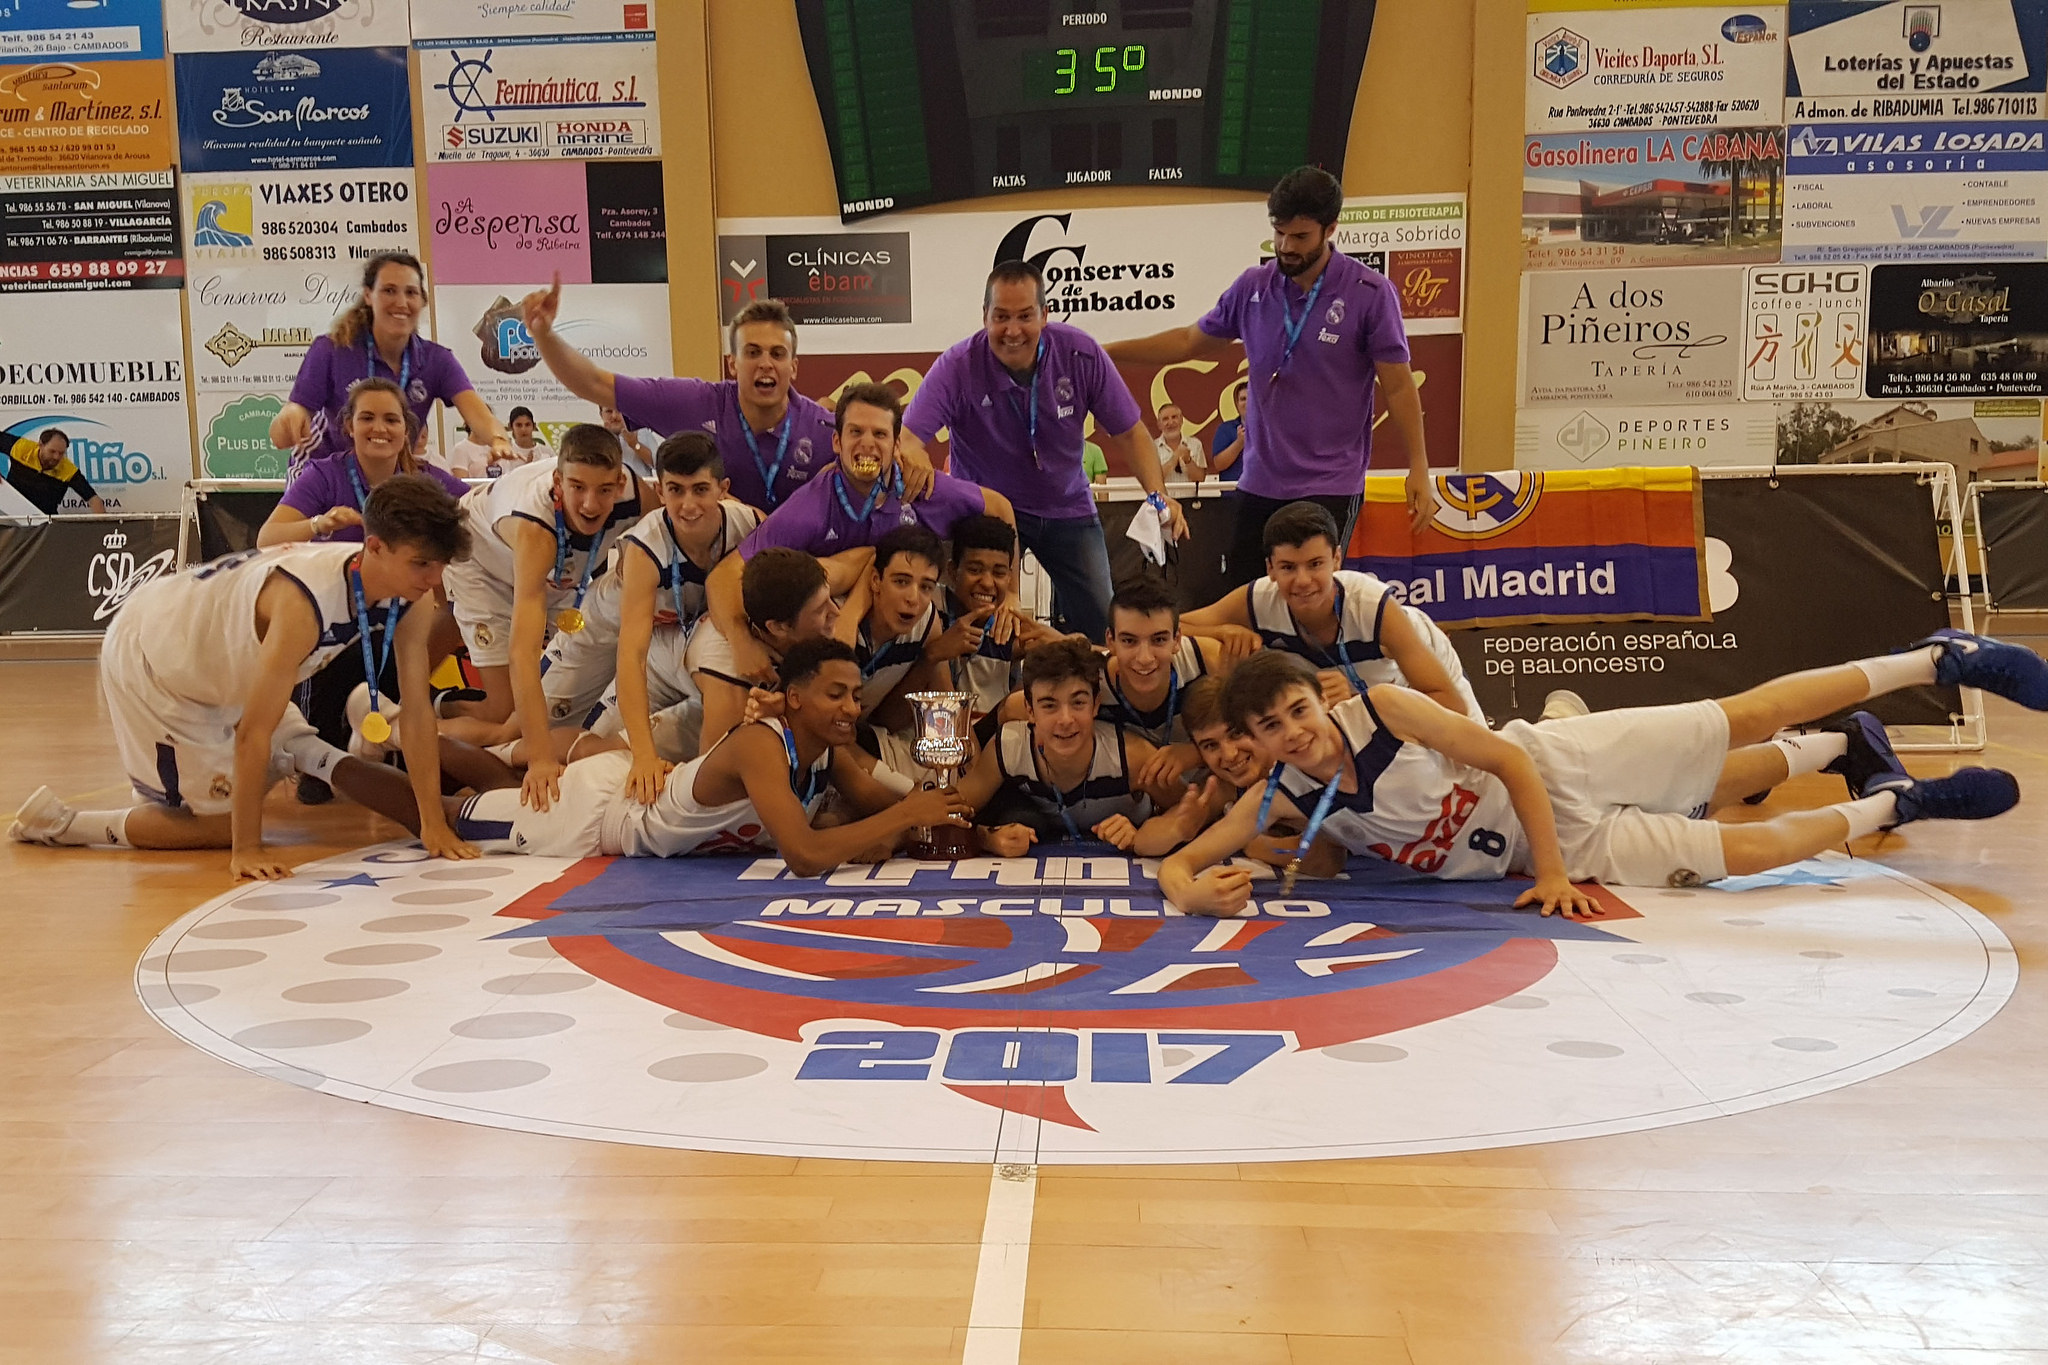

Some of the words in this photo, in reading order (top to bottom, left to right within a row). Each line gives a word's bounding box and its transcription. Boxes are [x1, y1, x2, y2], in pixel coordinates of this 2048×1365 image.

[1062, 12, 1108, 27] PERIODO
[240, 26, 339, 48] Restaurante
[1594, 47, 1639, 69] Vieites
[1642, 45, 1699, 72] Daporta,
[1701, 43, 1725, 65] S.L.
[1824, 53, 1903, 72] Loterías
[1909, 56, 1921, 74] y
[1926, 54, 2014, 73] Apuestas
[1593, 70, 1656, 86] CORREDURÍA
[1659, 72, 1673, 83] DE
[1677, 70, 1724, 82] SEGUROS
[1877, 73, 1904, 90] del
[1914, 72, 1980, 90] Estado
[612, 75, 638, 102] s.l.
[1148, 87, 1203, 101] MONDO
[35, 106, 45, 121] &
[139, 98, 162, 120] s.l.
[212, 100, 294, 128] San
[295, 96, 370, 132] Marcos
[1851, 102, 1868, 117] de
[1873, 98, 1944, 117] RIBADUMIA
[23, 126, 67, 138] CENTRO
[69, 125, 84, 136] DE
[86, 124, 149, 136] RECICLADO
[468, 126, 539, 145] SUZUKI
[556, 122, 632, 133] HONDA
[291, 137, 301, 147] tu
[303, 136, 345, 150] banquete
[347, 135, 382, 145] soñado
[557, 132, 634, 145] MARINE
[1843, 132, 1922, 154] VILAS
[1934, 131, 2044, 153] LOSADA
[1525, 139, 1638, 168] Gasolinera
[1645, 136, 1675, 163] LA
[1681, 131, 1780, 162] CABANA
[4, 175, 86, 190] VETERINARIA
[90, 174, 118, 187] SAN
[122, 173, 171, 186] MIGUEL
[992, 173, 1026, 188] FALTAS
[1065, 169, 1112, 184] JUGADOR
[1148, 167, 1183, 181] FALTAS
[259, 185, 334, 204] VIAXES
[339, 181, 409, 203] OTERO
[5, 203, 16, 213] Tel.
[19, 202, 33, 212] 986
[35, 202, 44, 211] 55
[46, 202, 55, 211] 56
[56, 201, 67, 210] 78
[74, 201, 94, 210] SAN
[97, 200, 133, 210] MIGUEL
[134, 199, 171, 209] (Vilanova)
[454, 197, 474, 214] A
[843, 196, 895, 214] MONDO
[1796, 202, 1833, 210] LABORAL
[1966, 199, 2036, 207] EMPRENDEDORES
[1372, 209, 1386, 219] DE
[1389, 205, 1461, 219] FISIOTERAPIA
[42, 219, 53, 230] Tel.
[56, 219, 70, 228] 986
[71, 218, 81, 228] 50
[83, 218, 92, 227] 88
[95, 217, 103, 227] 19
[109, 215, 172, 227] VILLAGARCÍA
[261, 222, 285, 235] 986
[346, 220, 408, 233] Cambados
[435, 201, 580, 250] despensa
[609, 218, 651, 228] Cambados
[1796, 220, 1856, 229] SUBVENCIONES
[1965, 217, 1997, 226] NUEVAS
[1998, 217, 2041, 225] EMPRESAS
[7, 237, 19, 247] Tel.
[20, 237, 34, 246] 986
[36, 236, 45, 246] 71
[47, 236, 57, 245] 06
[58, 236, 68, 245] 76
[74, 235, 128, 245] BARRANTES
[130, 233, 173, 244] (Ribadumia)
[1337, 230, 1390, 248] Marga
[1396, 224, 1461, 242] Sobrido
[263, 247, 287, 260] 986
[787, 248, 892, 266] CLÍNICAS
[49, 262, 83, 277] 659
[88, 262, 110, 276] 88
[116, 261, 138, 275] 09
[145, 260, 167, 275] 27
[193, 275, 287, 306] Conservas
[1061, 283, 1083, 297] de
[1754, 271, 1860, 295] SOHO
[1920, 277, 1955, 288] Albariño
[1571, 281, 1597, 310] A
[1609, 280, 1664, 309] dos
[1918, 291, 1936, 313] O
[1945, 286, 2011, 313] Casal
[1751, 298, 1802, 311] coffee
[1819, 297, 1862, 309] lunch
[803, 315, 882, 325] www.clinicasebam.com
[1979, 314, 2009, 324] Tapería
[1541, 311, 1691, 345] Piñeiros
[1591, 360, 1682, 378] TAPERÍA
[1915, 384, 1943, 394] 36630
[1944, 384, 1986, 393] Cambados
[1996, 383, 2042, 392] Pontevedra
[53, 394, 68, 404] Tel.
[70, 393, 86, 403] 986
[88, 393, 105, 403] 542
[107, 393, 123, 402] 140
[129, 392, 180, 402] CAMBADOS
[1618, 418, 1730, 433] DEPORTES
[217, 436, 249, 450] PLUS
[252, 439, 267, 450] DE
[1618, 434, 1707, 450] PIÑEIRO
[87, 552, 135, 598] CSD
[1384, 568, 1445, 607] eal
[1462, 560, 1617, 600] Madrid
[1468, 827, 1507, 857] 8
[794, 1028, 1303, 1085] 2017
